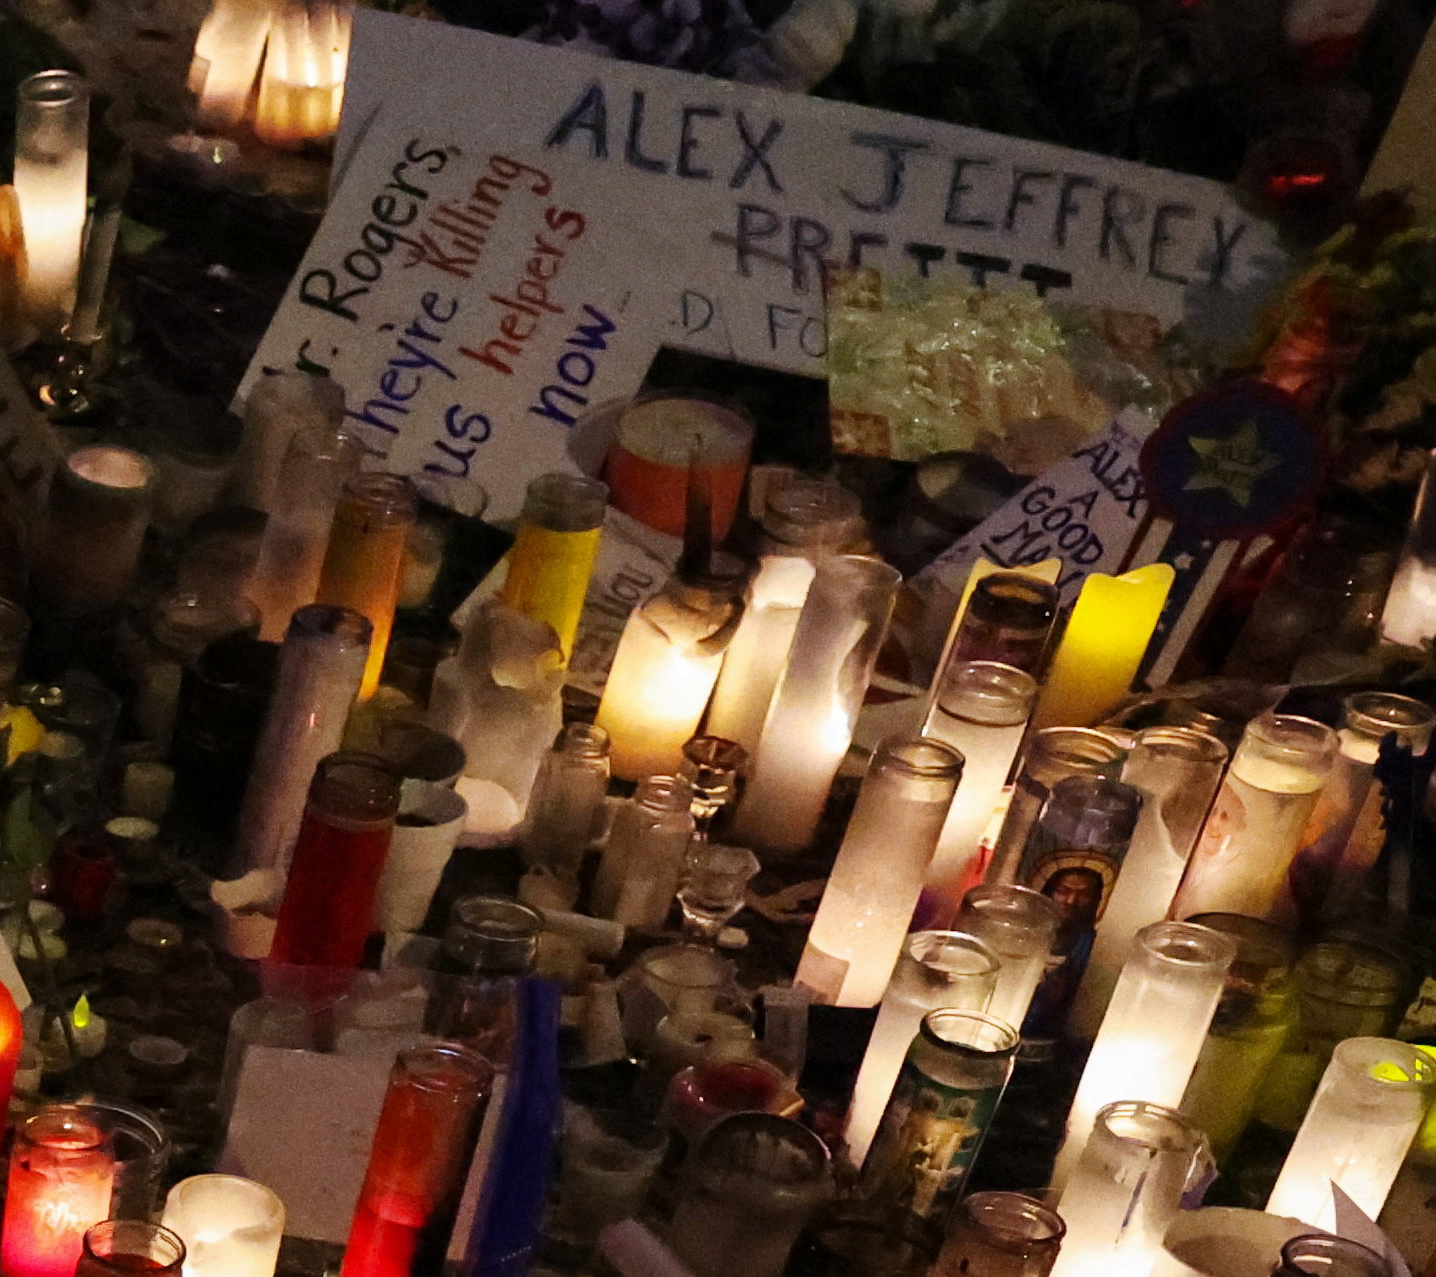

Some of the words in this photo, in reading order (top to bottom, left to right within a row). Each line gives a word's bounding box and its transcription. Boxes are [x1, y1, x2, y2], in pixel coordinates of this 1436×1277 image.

[544, 77, 785, 195] ALEX
[836, 128, 1250, 288] JEFFREY
[298, 138, 461, 324] Rogers,
[456, 190, 586, 376] helpers
[422, 403, 491, 478] us
[1070, 440, 1141, 519] ALEX
[1009, 485, 1104, 565] GOOD
[1062, 489, 1099, 519] A
